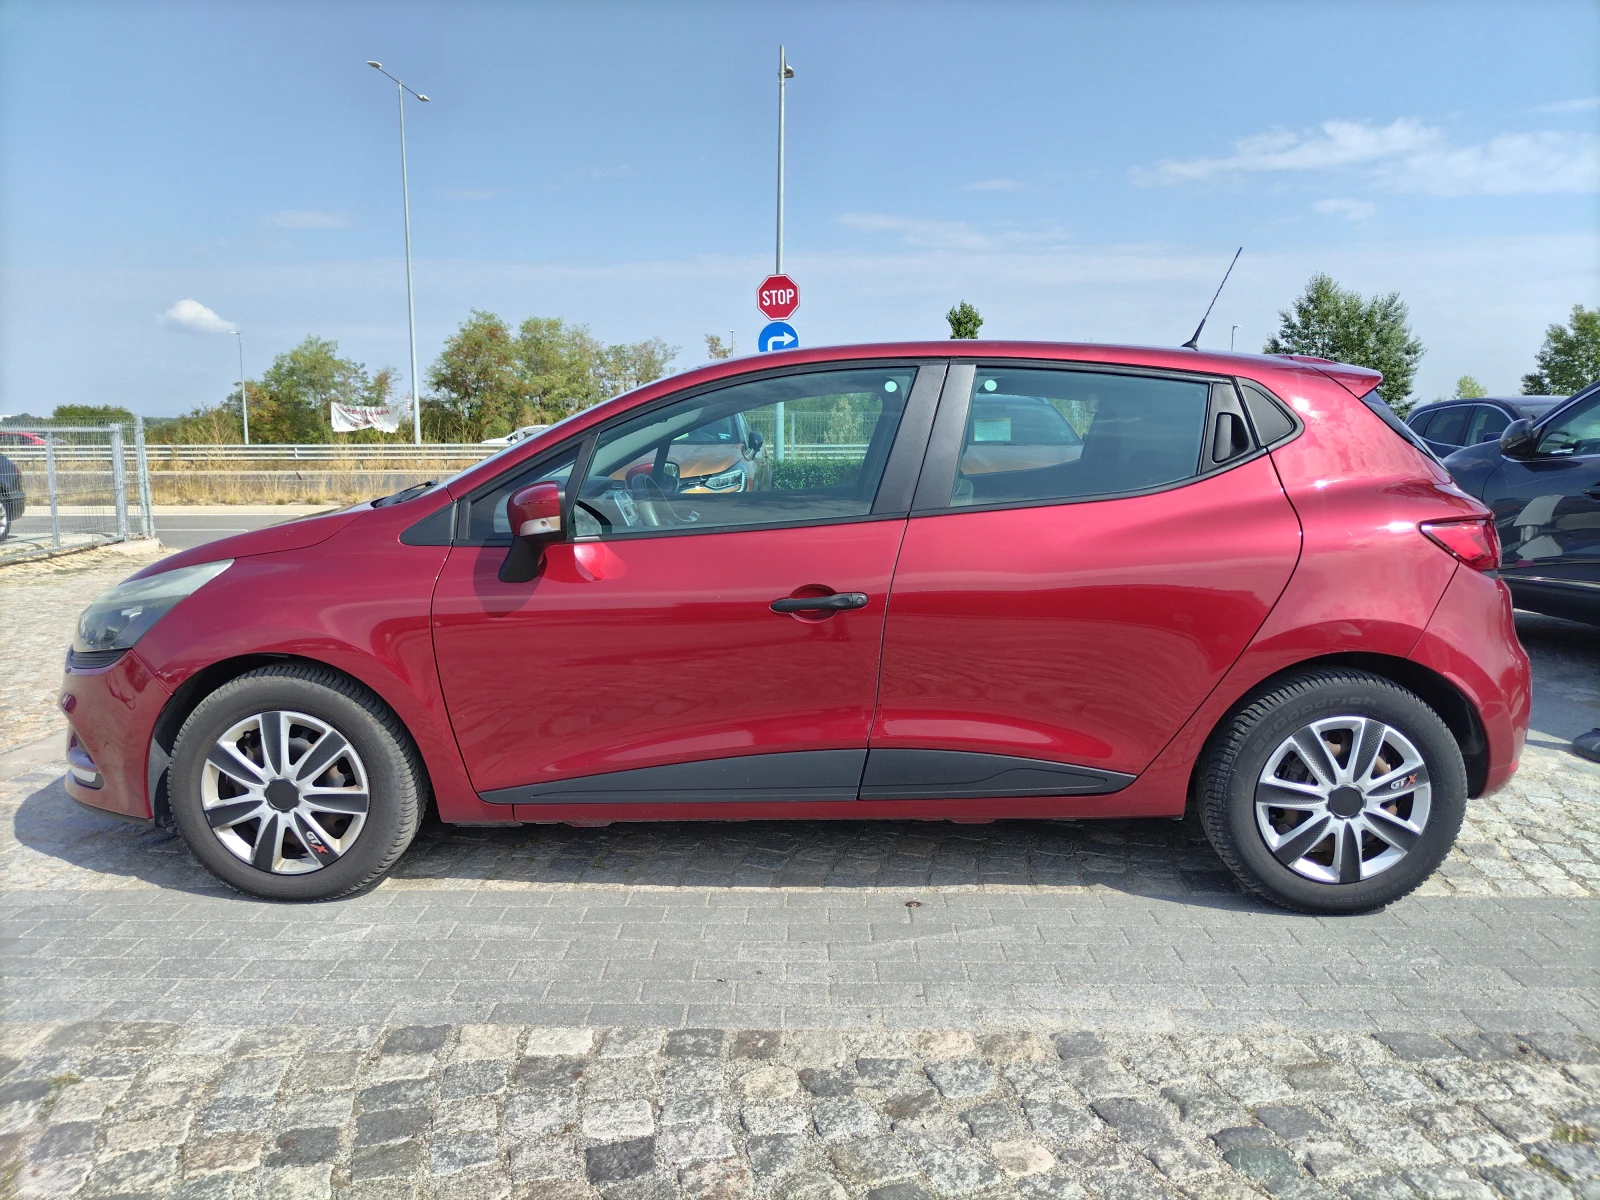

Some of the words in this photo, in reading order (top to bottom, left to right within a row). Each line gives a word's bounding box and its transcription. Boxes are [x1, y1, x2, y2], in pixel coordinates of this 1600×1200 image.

[762, 288, 795, 306] STOP
[1252, 696, 1377, 755] BFGoodrich
[1390, 773, 1416, 789] GTX
[306, 831, 328, 853] GTX
